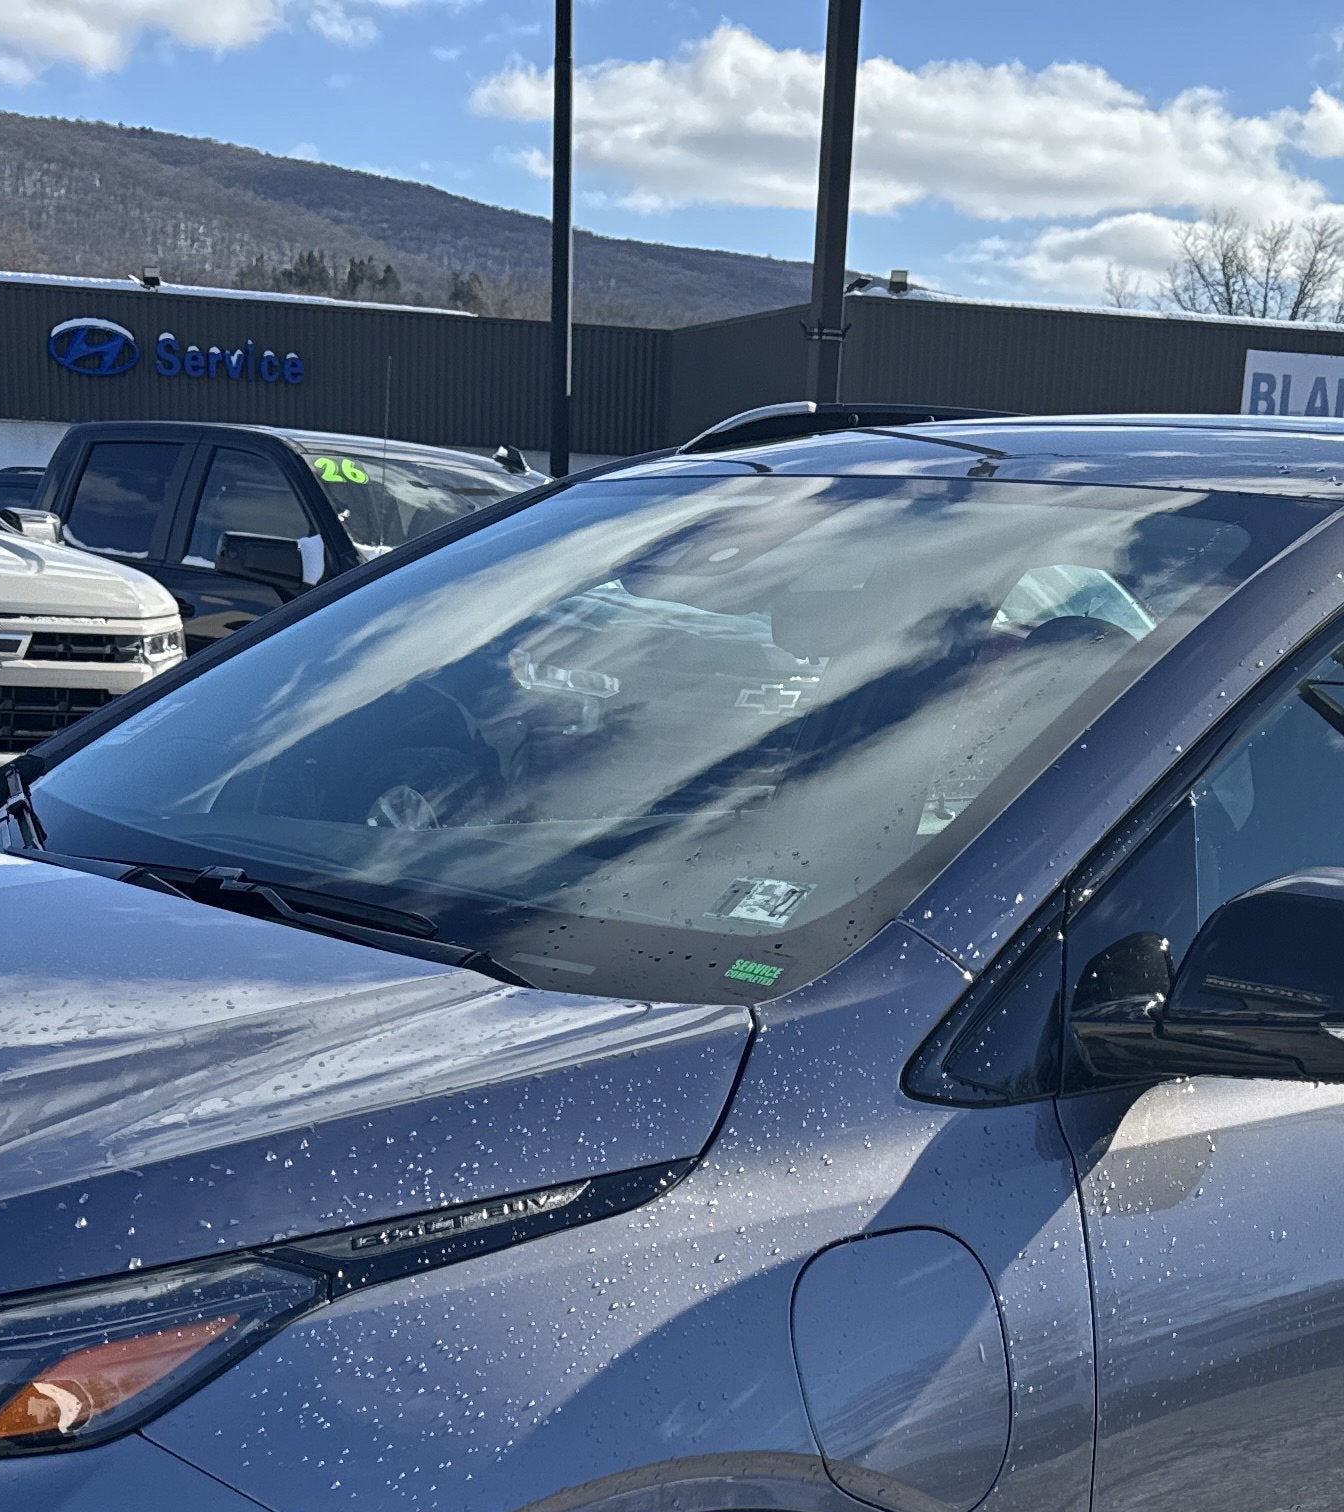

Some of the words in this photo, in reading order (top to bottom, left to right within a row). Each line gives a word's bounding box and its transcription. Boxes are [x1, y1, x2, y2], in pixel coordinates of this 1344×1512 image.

[156, 334, 304, 384] Service
[314, 457, 369, 485] 26
[732, 959, 784, 978] SERVICE
